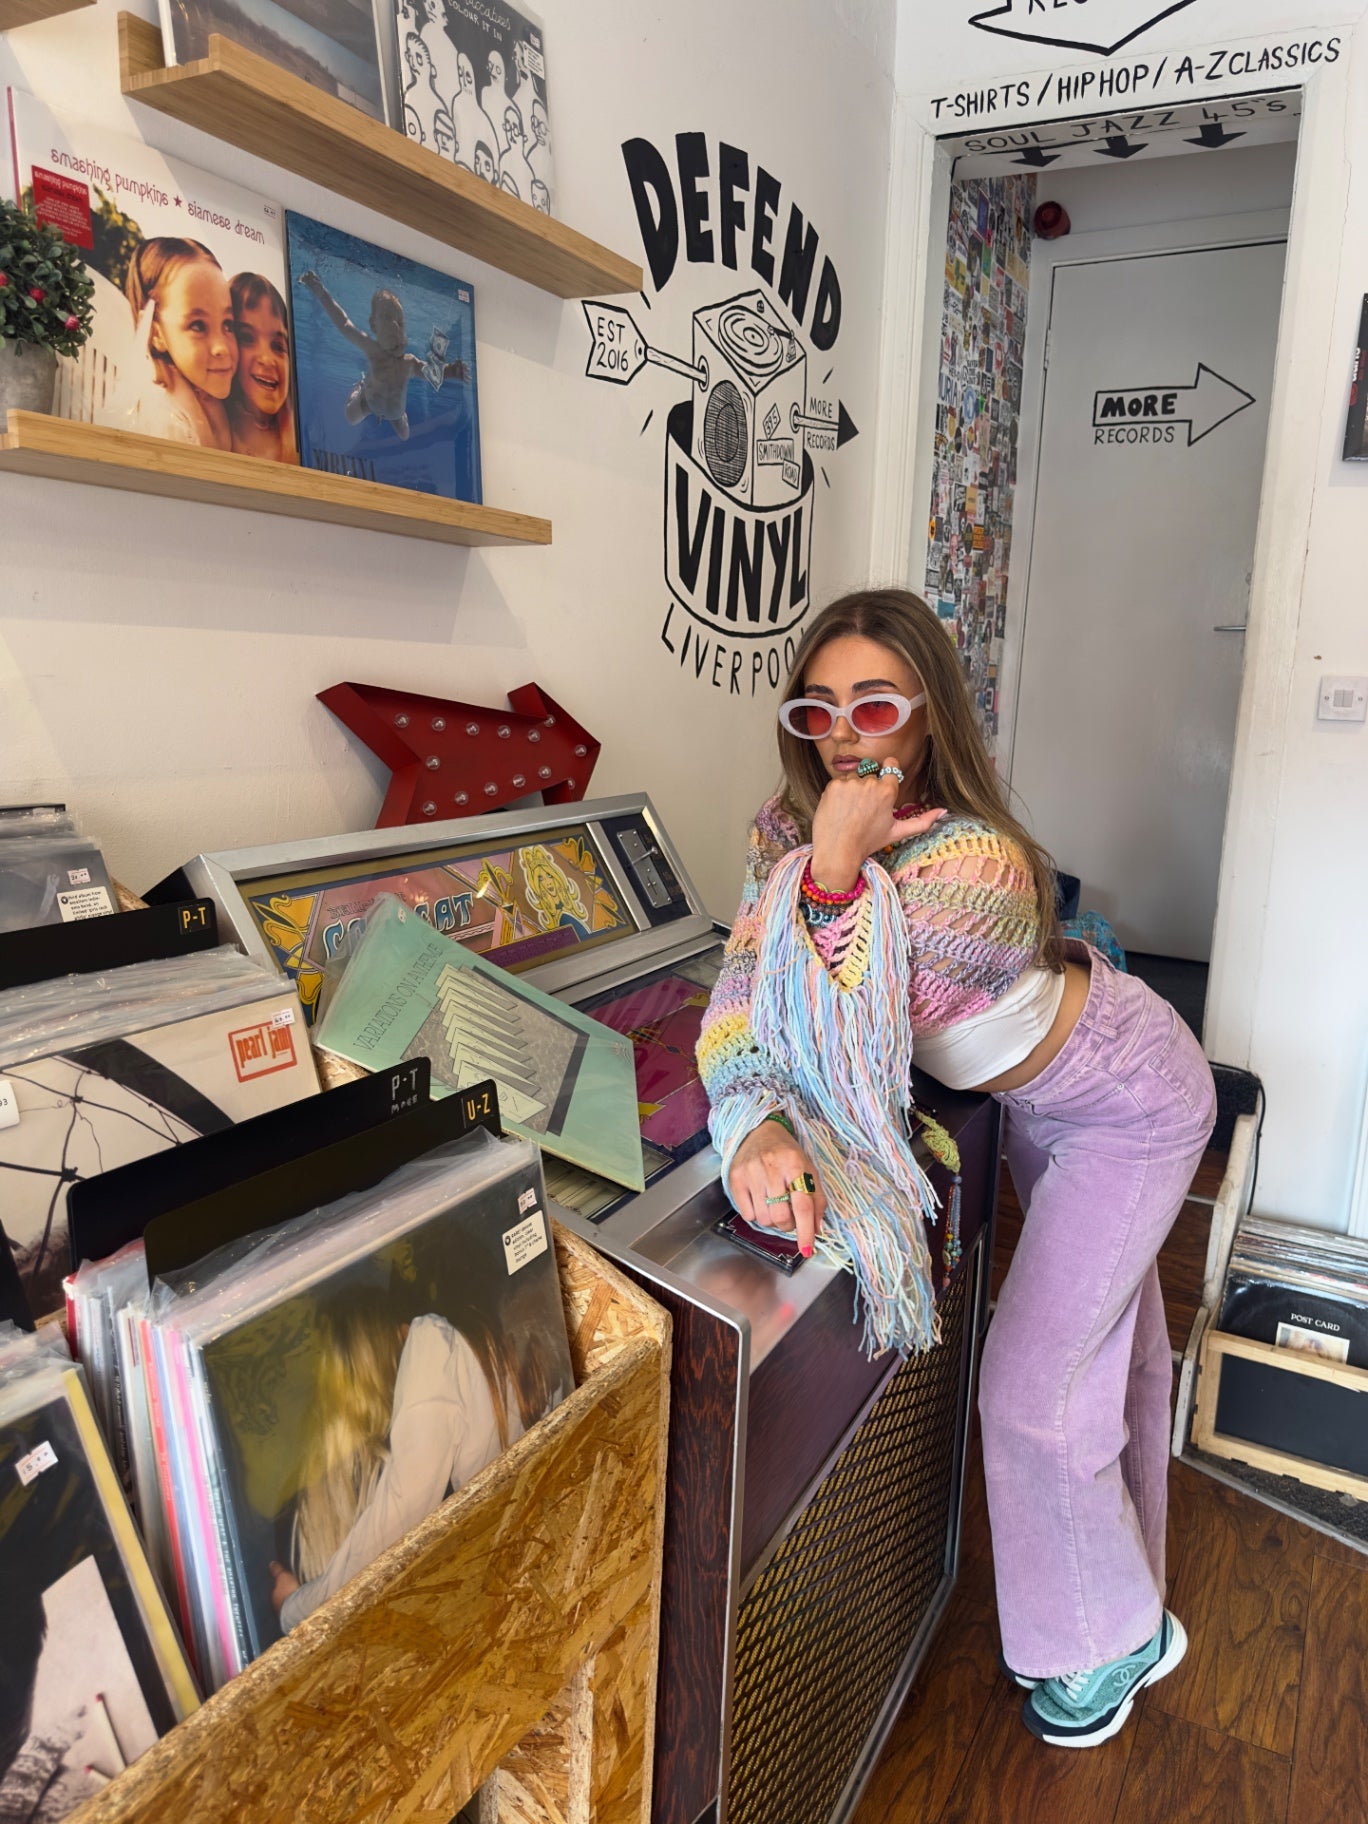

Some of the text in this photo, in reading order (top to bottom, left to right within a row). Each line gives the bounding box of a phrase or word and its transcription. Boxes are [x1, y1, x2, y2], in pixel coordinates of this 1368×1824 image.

[931, 81, 1029, 119] T-SHIRTS
[964, 131, 1056, 151] SOUL
[1070, 111, 1180, 138] JAZZ
[51, 149, 111, 190] smashing
[115, 173, 169, 206] pumpkins
[188, 200, 231, 230] siamese
[235, 219, 265, 245] dream
[621, 131, 842, 351] DEFEND
[597, 316, 625, 345] EST
[596, 341, 629, 372] 2016
[809, 397, 833, 418] MORE
[1100, 392, 1178, 418] MORE
[764, 410, 778, 436] 395
[1094, 426, 1175, 445] RECORDS
[758, 442, 794, 461] SMITHDOWN
[806, 431, 835, 451] RECORDS
[676, 462, 807, 624] VINYL
[661, 602, 804, 698] LIVERPOO
[182, 907, 207, 929] P-T
[353, 993, 407, 1051] VARIATIONS
[396, 978, 417, 998] ON
[413, 943, 443, 980] THEME
[235, 1026, 291, 1068] pearl jam
[467, 1093, 490, 1121] U-Z
[1291, 1312, 1341, 1332] POST CARD
